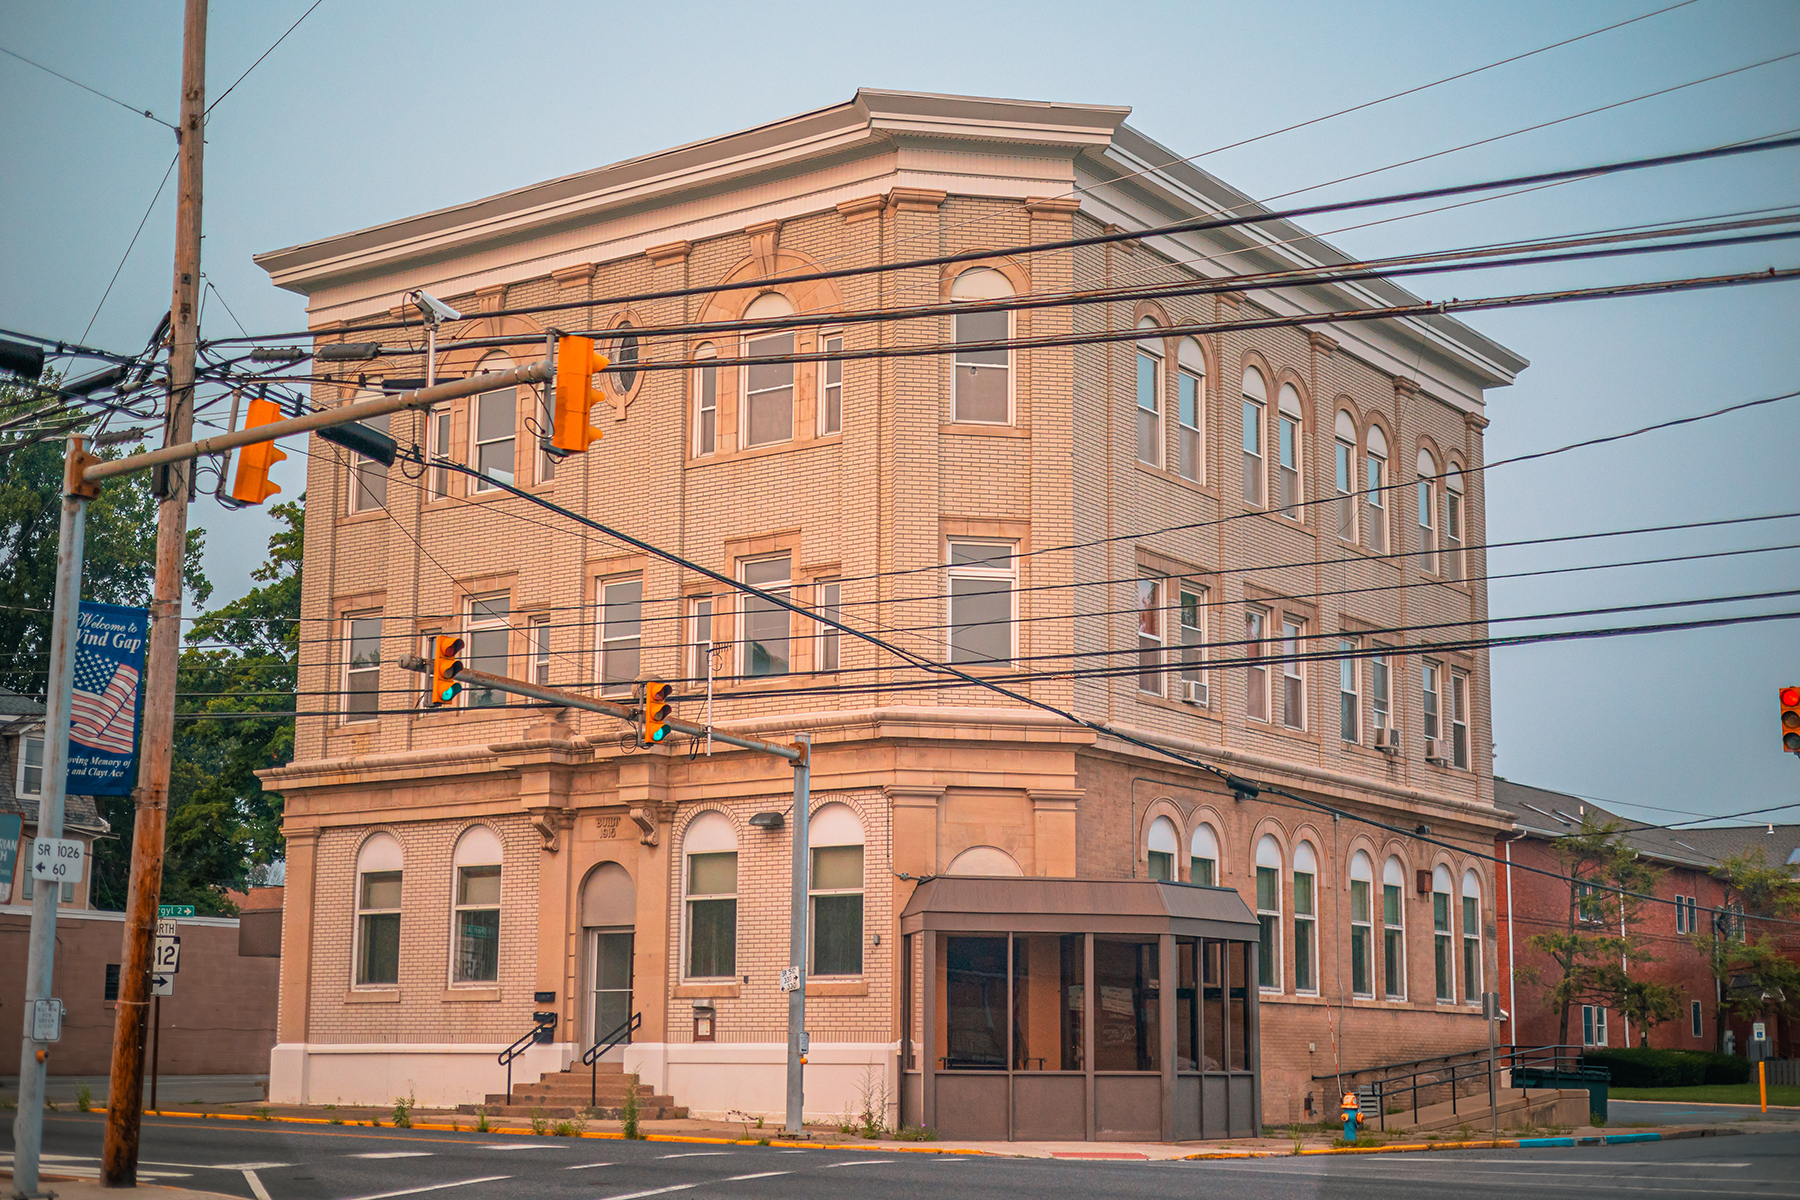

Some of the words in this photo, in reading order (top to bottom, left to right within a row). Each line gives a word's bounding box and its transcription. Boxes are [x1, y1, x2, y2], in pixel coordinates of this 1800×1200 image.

[77, 612, 126, 632] Welcome
[127, 622, 138, 633] to
[112, 633, 142, 654] Gap
[67, 755, 89, 767] oving
[91, 756, 121, 768] Memory
[123, 759, 132, 769] of
[71, 767, 87, 776] and
[596, 816, 621, 828] BUILT
[38, 844, 51, 856] SR
[57, 846, 80, 859] 1026
[52, 864, 66, 876] 60
[177, 906, 183, 915] 2
[154, 946, 175, 965] 12
